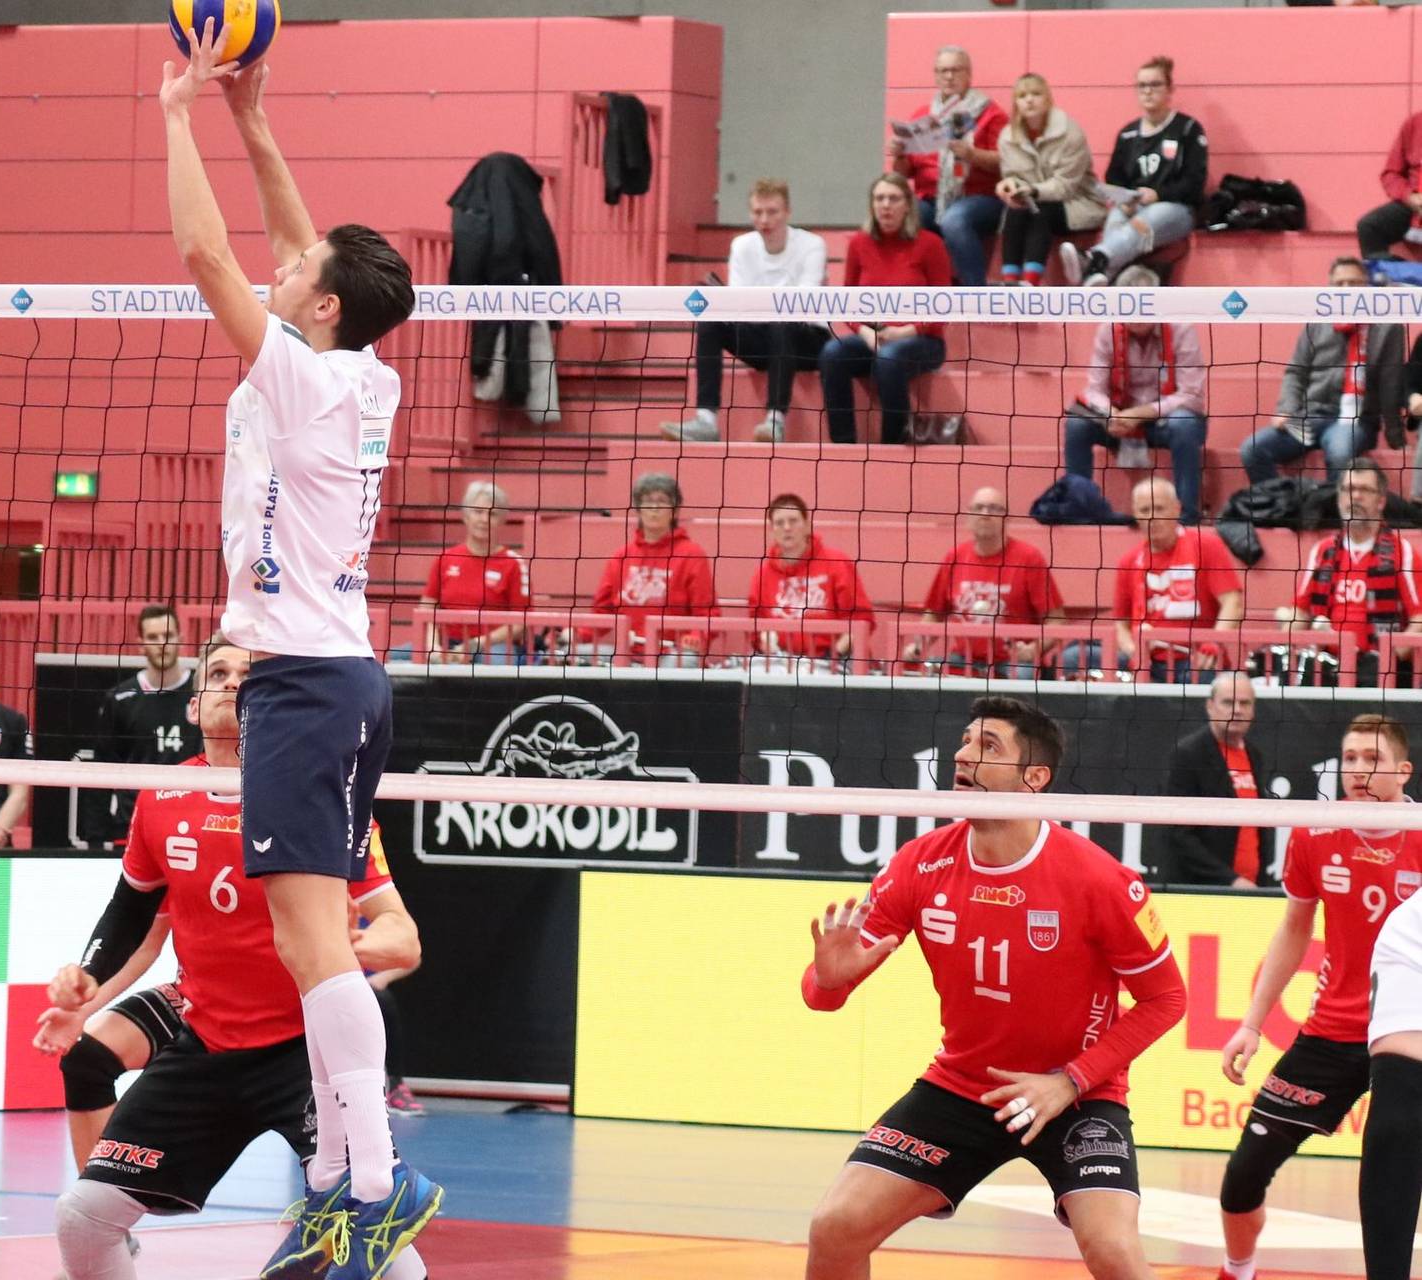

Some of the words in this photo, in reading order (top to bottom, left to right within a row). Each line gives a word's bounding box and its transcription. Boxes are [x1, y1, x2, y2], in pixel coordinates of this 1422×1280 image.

[466, 292, 503, 313] AM
[512, 291, 622, 314] NECKAR
[772, 292, 1155, 316] WWW.SW-ROTTENBURG.DE
[265, 469, 280, 519] PLASTI
[263, 524, 273, 554] INDE
[156, 725, 183, 752] 14
[435, 800, 677, 851] KROKODIL
[917, 856, 954, 874] Kempa
[210, 866, 238, 913] 6
[1362, 885, 1387, 923] 9
[967, 935, 1010, 985] 11
[1079, 1164, 1121, 1177] Kempa
